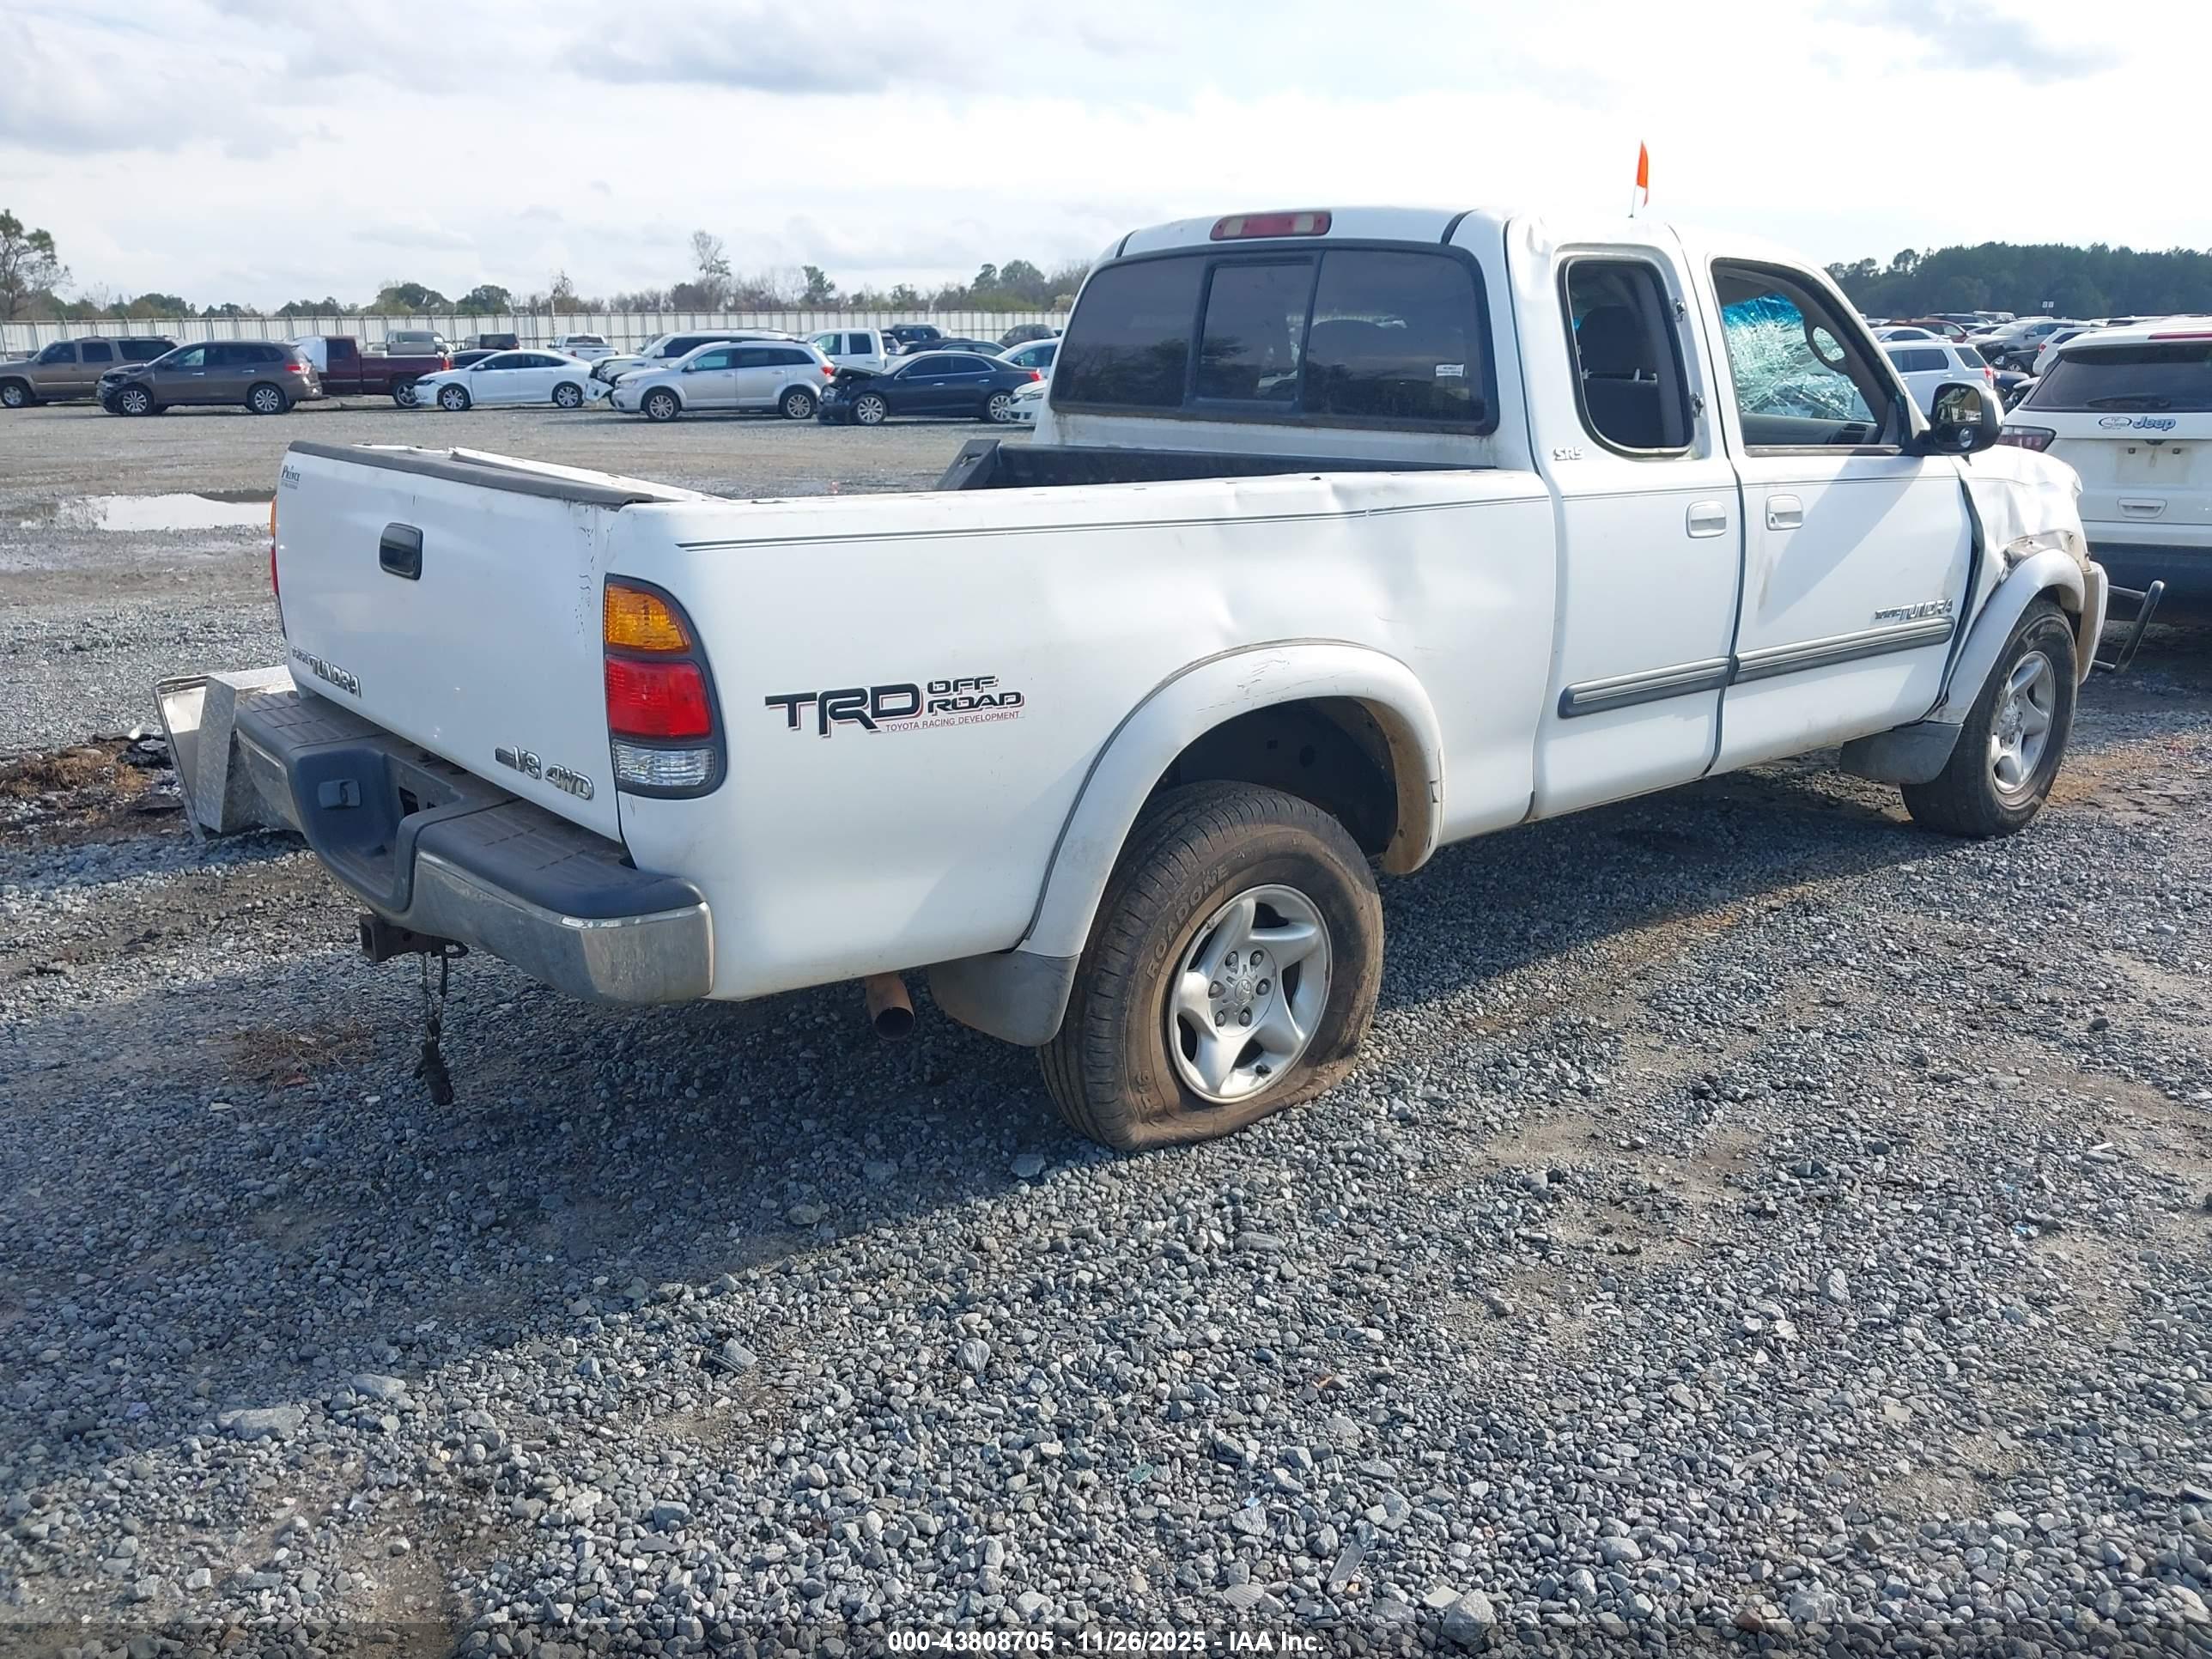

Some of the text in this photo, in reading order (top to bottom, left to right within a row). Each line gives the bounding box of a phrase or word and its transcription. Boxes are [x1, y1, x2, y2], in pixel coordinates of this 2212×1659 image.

[2132, 416, 2177, 432] Jeep
[309, 653, 362, 698] TUNDRA
[927, 675, 999, 696] OFF
[764, 683, 923, 738] TRD
[927, 691, 1024, 716] ROAD
[885, 710, 1020, 732] TOYOTA RACING DEVELOPMENT
[514, 744, 542, 781] V8
[544, 763, 595, 801] 4WD
